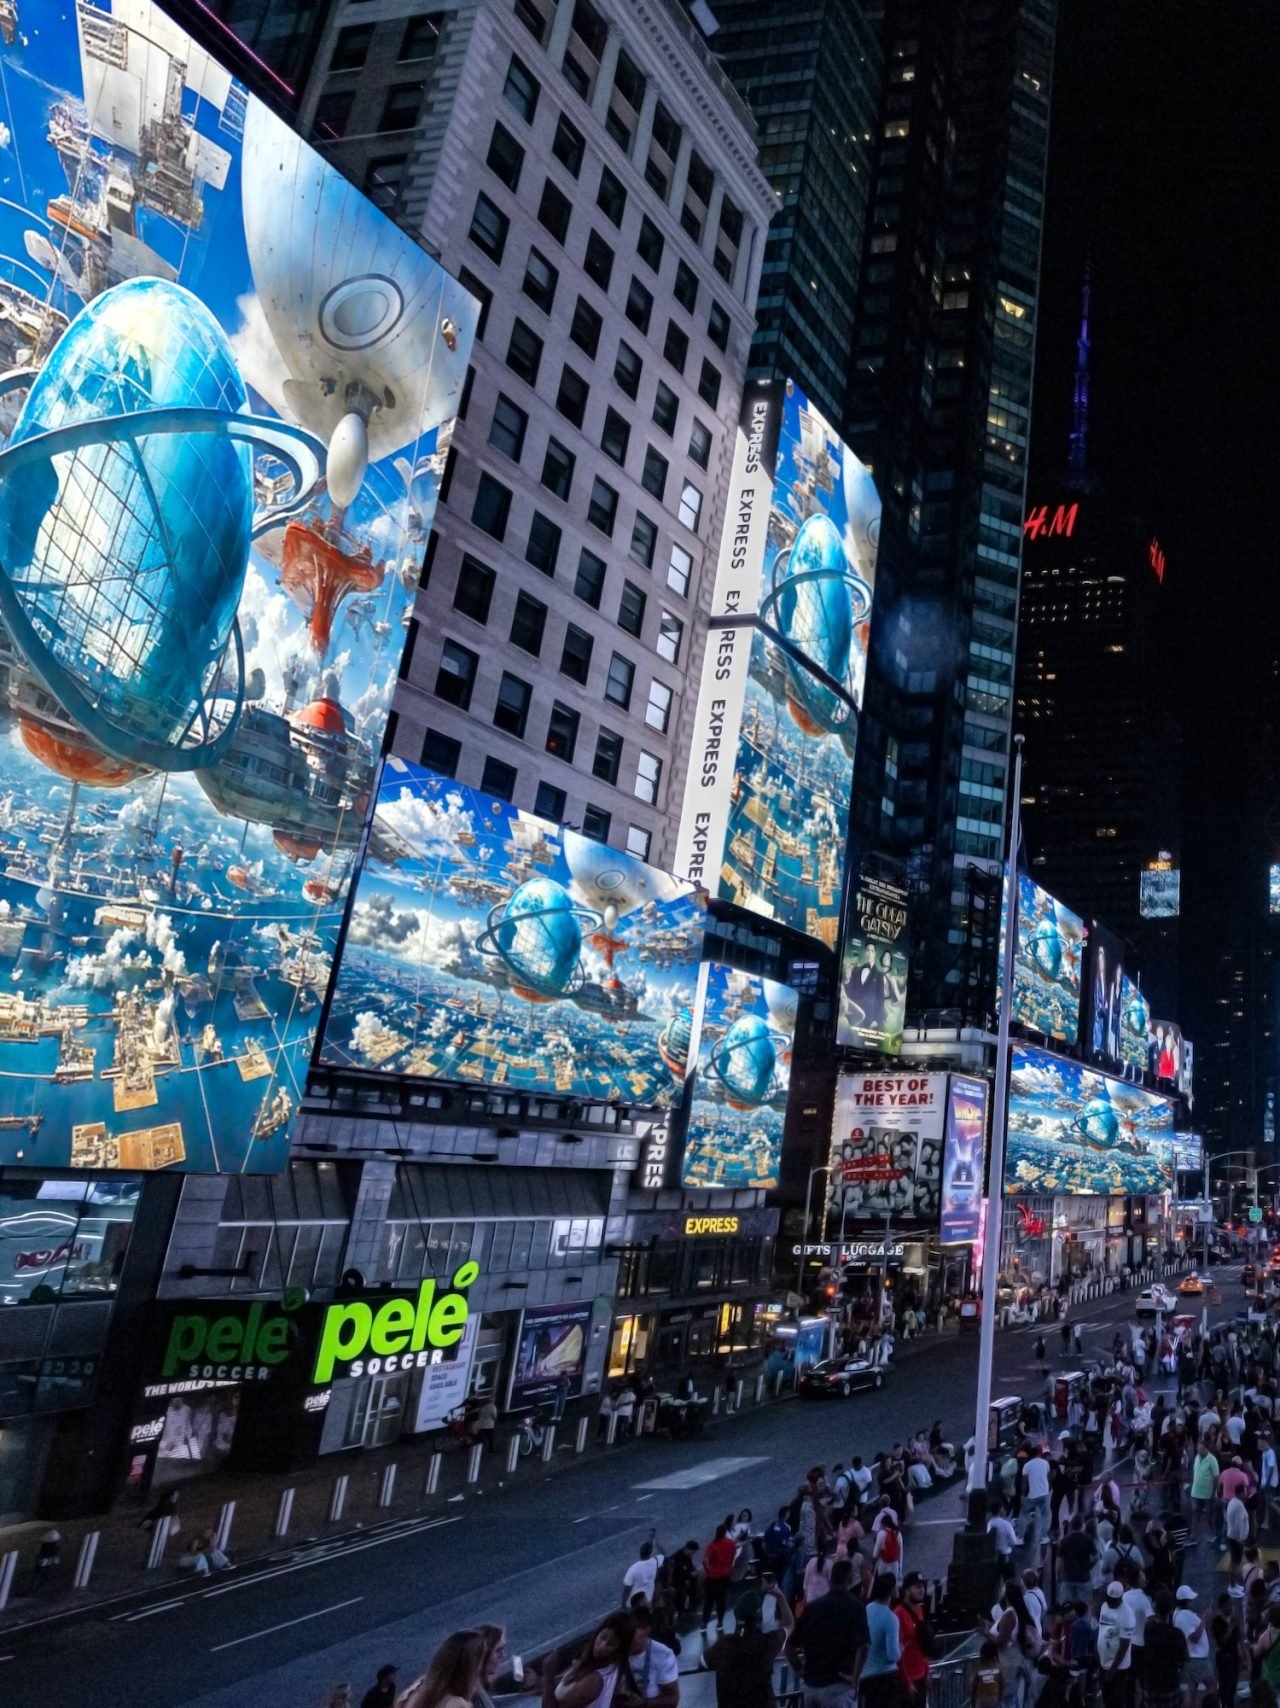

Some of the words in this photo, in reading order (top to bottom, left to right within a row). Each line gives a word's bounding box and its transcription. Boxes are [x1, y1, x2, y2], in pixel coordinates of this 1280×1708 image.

[745, 402, 769, 474] EXPRESS
[731, 489, 754, 570] EXPRESS
[701, 699, 726, 788] EXPRESS
[861, 914, 902, 940] GATSBY
[863, 1079, 905, 1092] BEST
[907, 1079, 929, 1091] OF
[854, 1093, 885, 1106] THE
[888, 1093, 934, 1106] YEAR!
[685, 1217, 739, 1235] EXPRESS
[792, 1245, 831, 1256] GIFTS
[842, 1245, 904, 1256] LUGGAGE
[189, 1364, 270, 1381] SOCCER
[350, 1349, 444, 1378] SOCCER
[144, 1385, 168, 1398] THE
